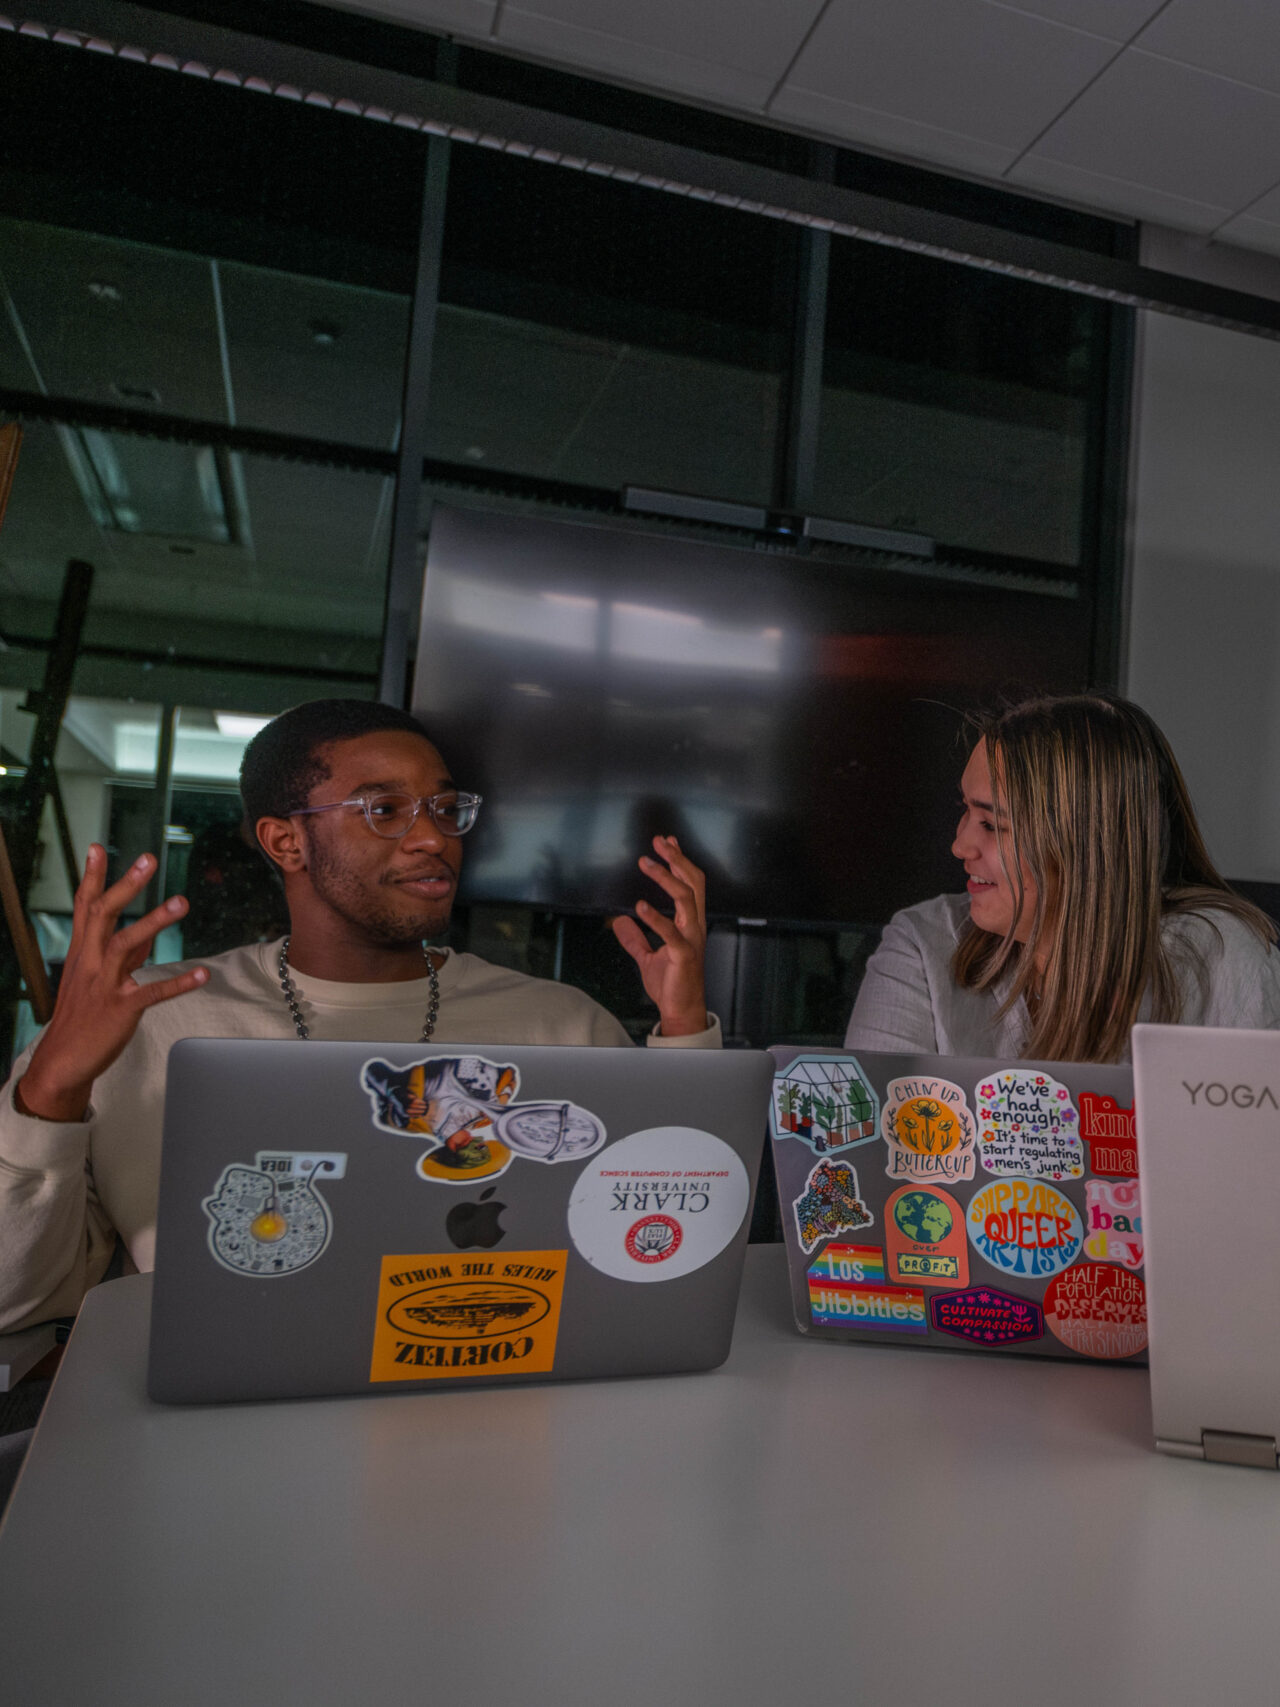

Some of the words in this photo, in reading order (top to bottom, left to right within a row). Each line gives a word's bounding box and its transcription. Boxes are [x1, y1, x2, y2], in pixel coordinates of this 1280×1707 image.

[894, 1082, 938, 1102] CHIN
[940, 1086, 960, 1102] UP
[997, 1078, 1050, 1097] We've
[1181, 1080, 1279, 1110] YOGA
[1007, 1094, 1043, 1112] had
[991, 1108, 1066, 1129] enough.
[994, 1129, 1016, 1143] It's
[1020, 1131, 1048, 1146] time
[1051, 1135, 1066, 1146] to
[983, 1143, 1015, 1156] start
[1019, 1146, 1081, 1165] regulating
[261, 1160, 292, 1173] IDEA
[600, 1169, 629, 1177] SCIENCE
[893, 1151, 971, 1177] BUTTERCUP
[994, 1157, 1031, 1170] men's
[1037, 1160, 1072, 1175] junk.
[630, 1170, 671, 1178] COMPUTER
[671, 1170, 682, 1178] OF
[613, 1182, 710, 1192] UNIVERSITY
[610, 1192, 710, 1213] CLARK
[971, 1180, 1076, 1223] SUPPORT
[984, 1207, 1075, 1250] QUEER
[976, 1233, 1080, 1275] ARTISTS
[461, 1263, 494, 1276] THE
[502, 1263, 558, 1282] RULES
[904, 1258, 950, 1273] PROFIT
[388, 1265, 453, 1287] WORLD
[1064, 1266, 1108, 1284] HALF
[1112, 1269, 1140, 1290] THE
[1056, 1282, 1144, 1303] POPULATION
[813, 1291, 925, 1321] Jibbities
[940, 1304, 1012, 1318] CULTIVATE
[941, 1316, 1034, 1332] COMPASSION
[394, 1336, 534, 1367] CORTEIZ
